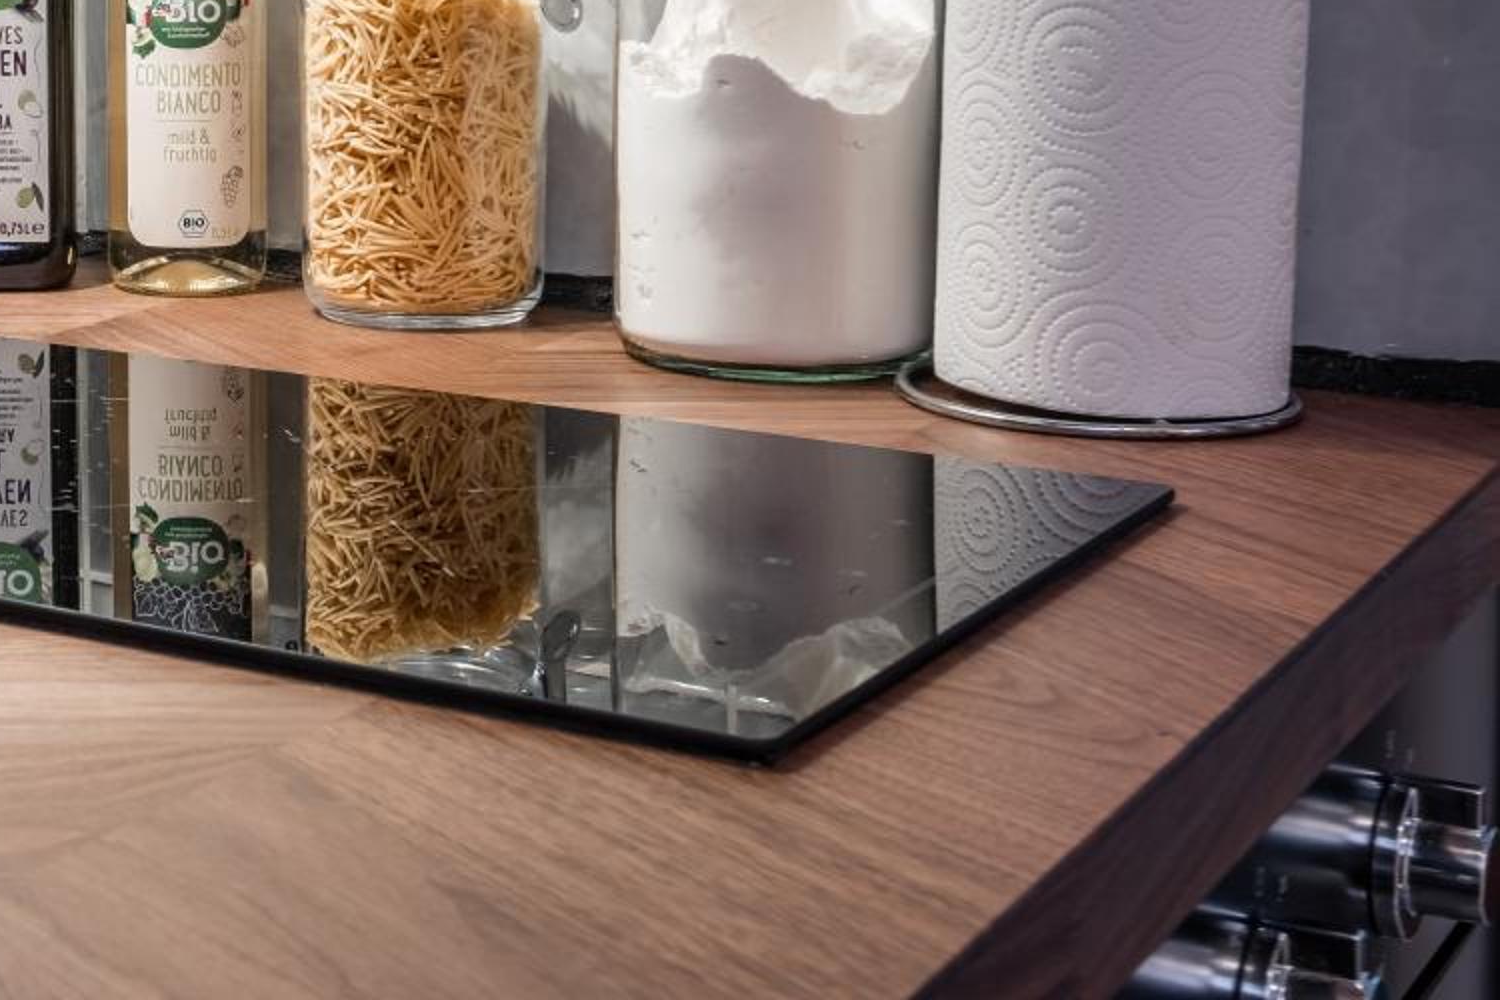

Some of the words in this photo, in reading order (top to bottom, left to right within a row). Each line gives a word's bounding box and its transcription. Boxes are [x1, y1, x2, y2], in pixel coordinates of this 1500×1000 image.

[135, 62, 242, 87] CONDIMENTO
[156, 90, 221, 114] BIANCO
[167, 128, 196, 144] mild
[199, 128, 211, 144] &
[183, 218, 205, 228] BIO
